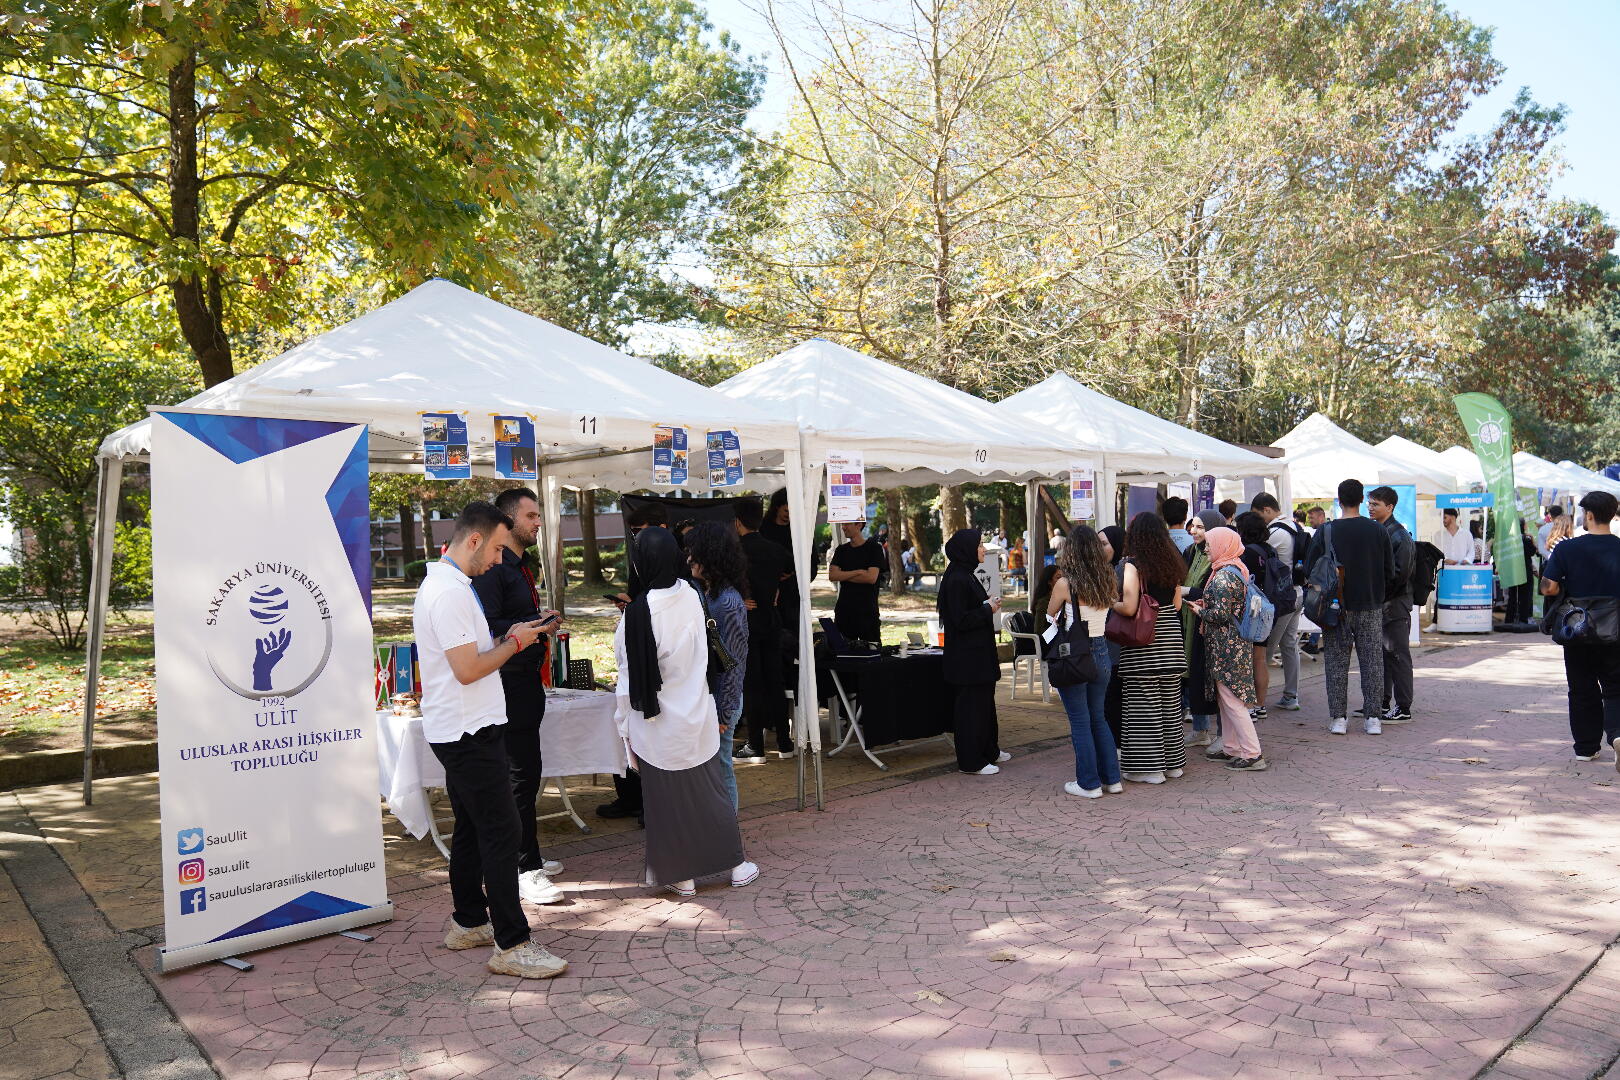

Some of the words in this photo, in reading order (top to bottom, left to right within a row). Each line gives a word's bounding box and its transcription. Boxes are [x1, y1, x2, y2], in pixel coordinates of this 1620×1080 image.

[579, 415, 597, 435] 11
[975, 449, 987, 463] 10
[206, 568, 253, 626] SAKARYA
[255, 561, 333, 621] ÜNİVERSİTESİ
[262, 696, 285, 708] 1992
[255, 706, 298, 728] ULİT
[180, 741, 249, 761] ULUSLAR
[252, 736, 293, 752] ARASI
[297, 728, 363, 747] İLİŞKİLER
[231, 749, 319, 772] TOPLULUĞU
[206, 830, 248, 846] SauUlit
[208, 860, 250, 877] sau.ulit
